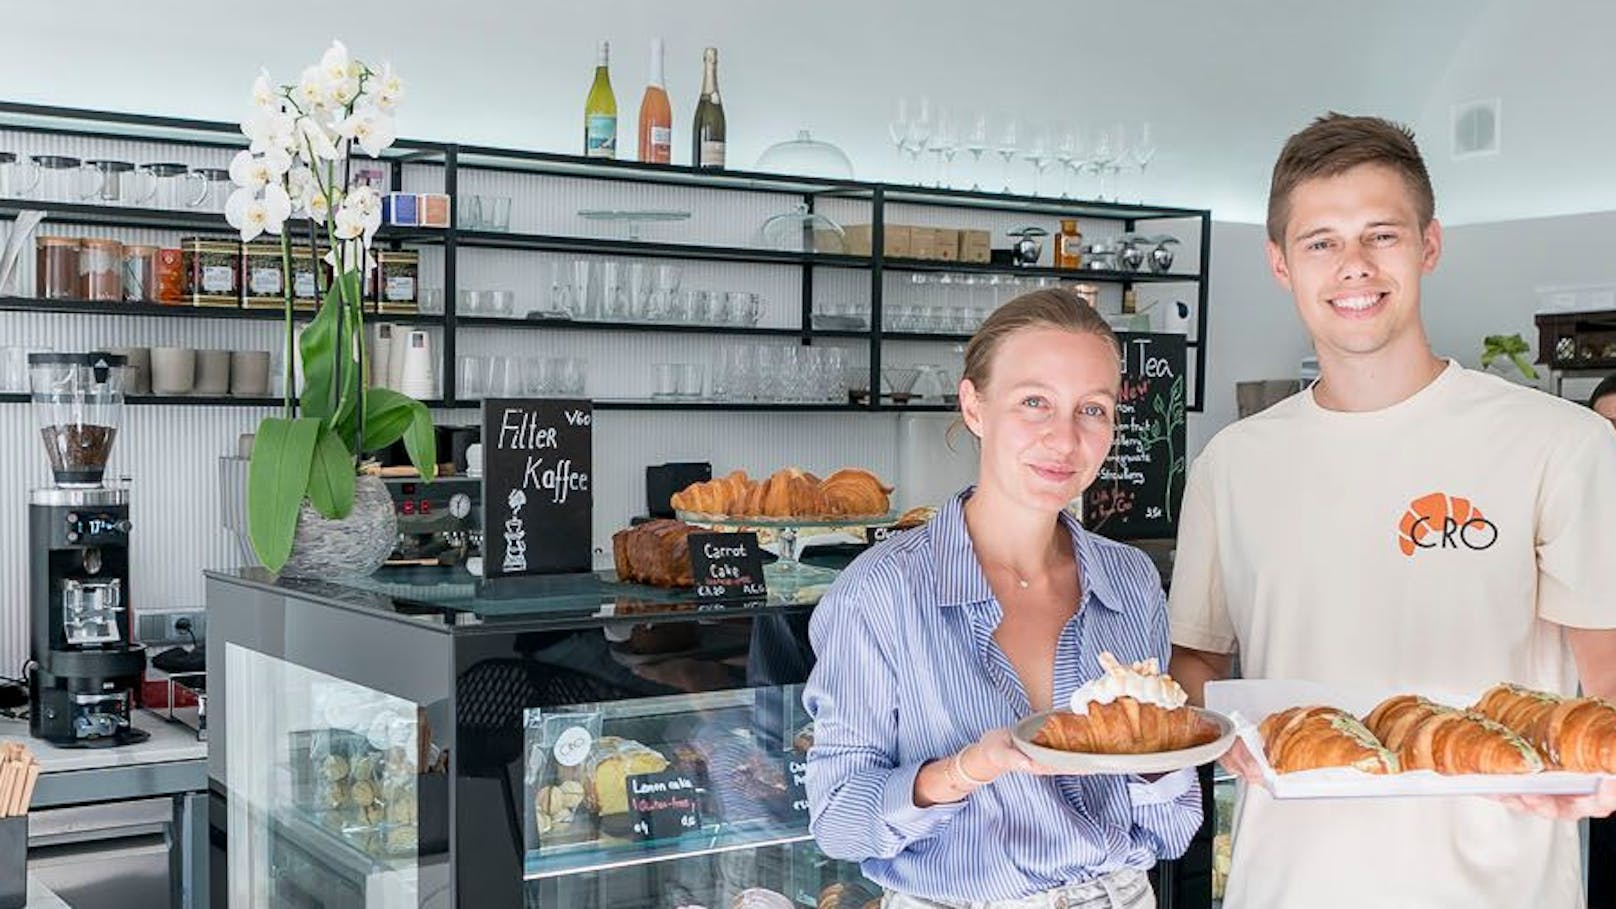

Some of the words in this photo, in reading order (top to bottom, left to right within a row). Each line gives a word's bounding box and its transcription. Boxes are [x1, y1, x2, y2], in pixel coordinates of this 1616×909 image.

[1133, 339, 1174, 378] Tea
[523, 456, 588, 504] Kaffee
[1411, 515, 1498, 550] CRO
[703, 542, 748, 560] Carrot
[709, 563, 741, 579] Cake
[632, 779, 667, 794] Lemon
